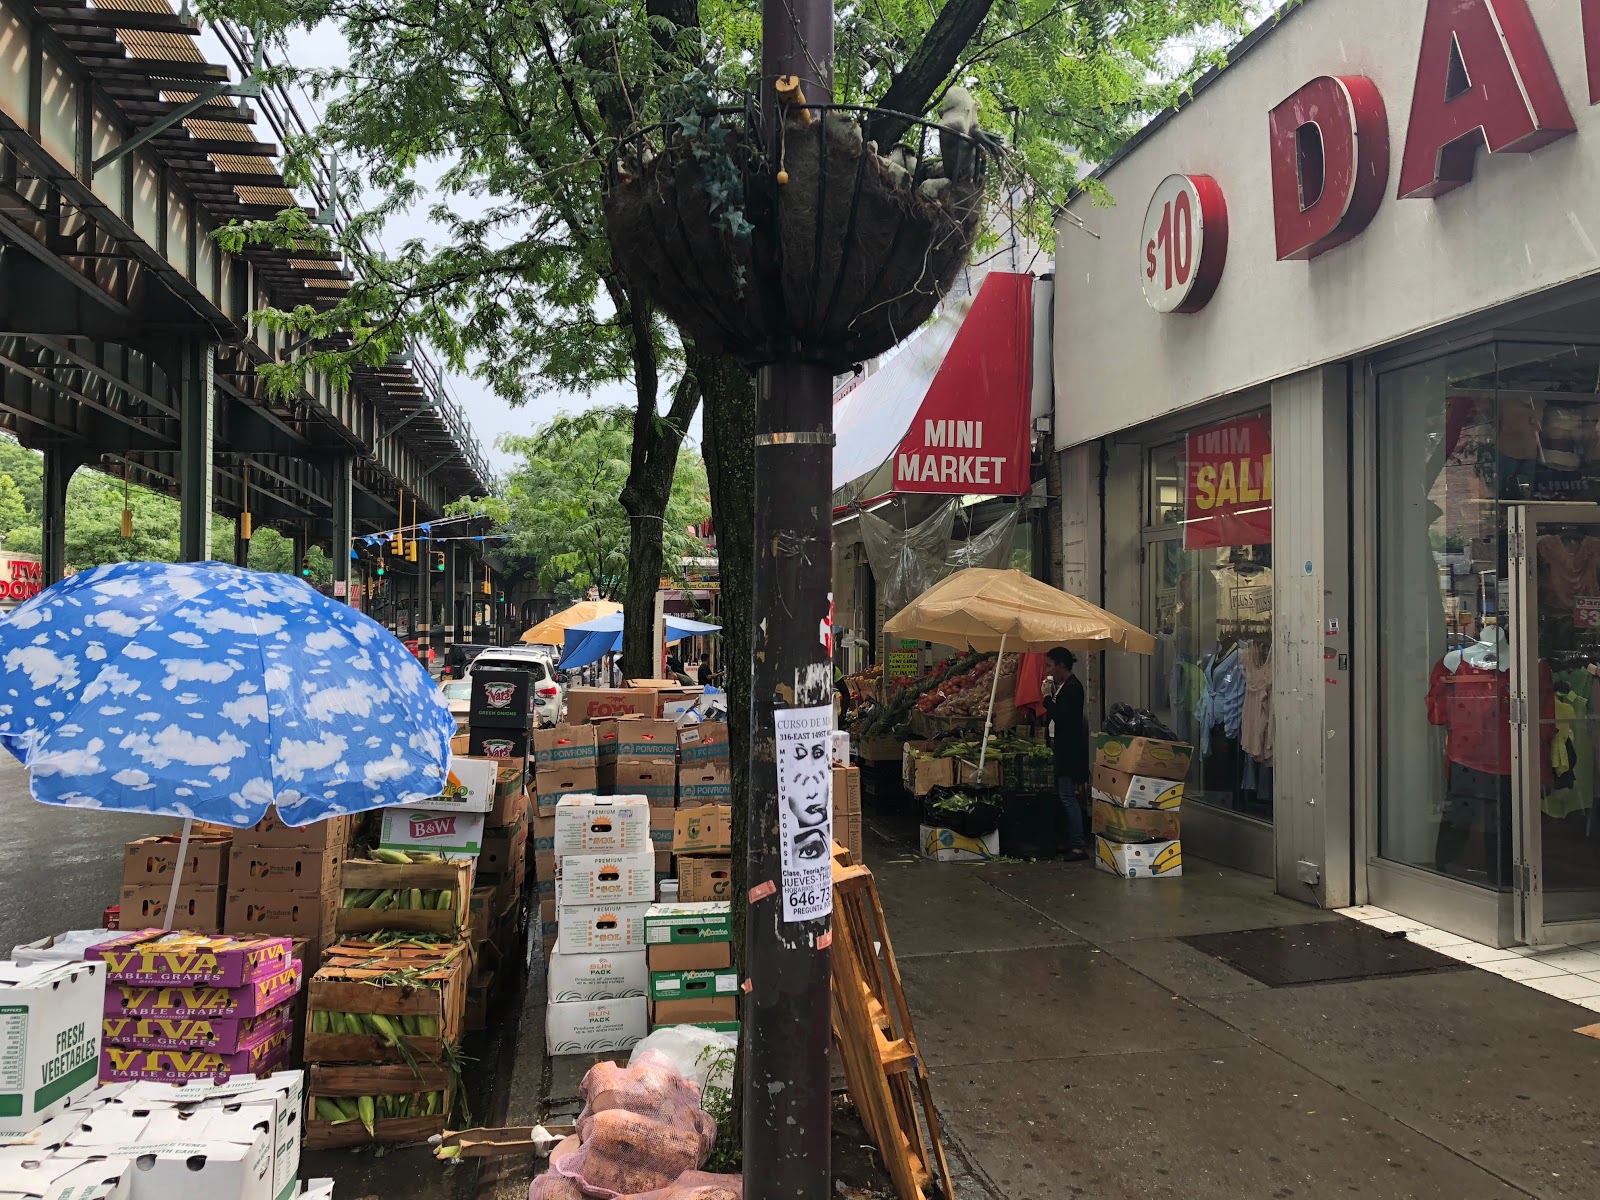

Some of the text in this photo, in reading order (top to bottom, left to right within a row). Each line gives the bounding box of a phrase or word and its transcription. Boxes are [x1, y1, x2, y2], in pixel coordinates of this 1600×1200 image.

[1269, 0, 1600, 261] DA
[1146, 190, 1192, 291] $10
[924, 419, 983, 448] MINI
[898, 454, 1007, 484] MARKET
[778, 719, 808, 729] CURSO
[810, 718, 821, 728] DE
[780, 732, 810, 741] 316-EAST
[554, 747, 593, 758] POIVRONS
[697, 786, 731, 794] POIVRON
[415, 819, 450, 837] B&W
[100, 952, 224, 973] VIVA
[247, 944, 286, 966] VIVA
[106, 972, 152, 980] TABLE
[161, 973, 221, 981] GRAPES
[259, 968, 297, 995] VIVA
[118, 987, 237, 1009] VIVA
[56, 1022, 85, 1054] FRESH
[104, 1018, 220, 1040] VIVA
[158, 1038, 216, 1047] GRAPES
[252, 1029, 288, 1060] VIVA
[42, 1038, 96, 1085] VEGETABLES
[105, 1048, 230, 1072] VIVA
[111, 1070, 227, 1078] TABLE GRAPES
